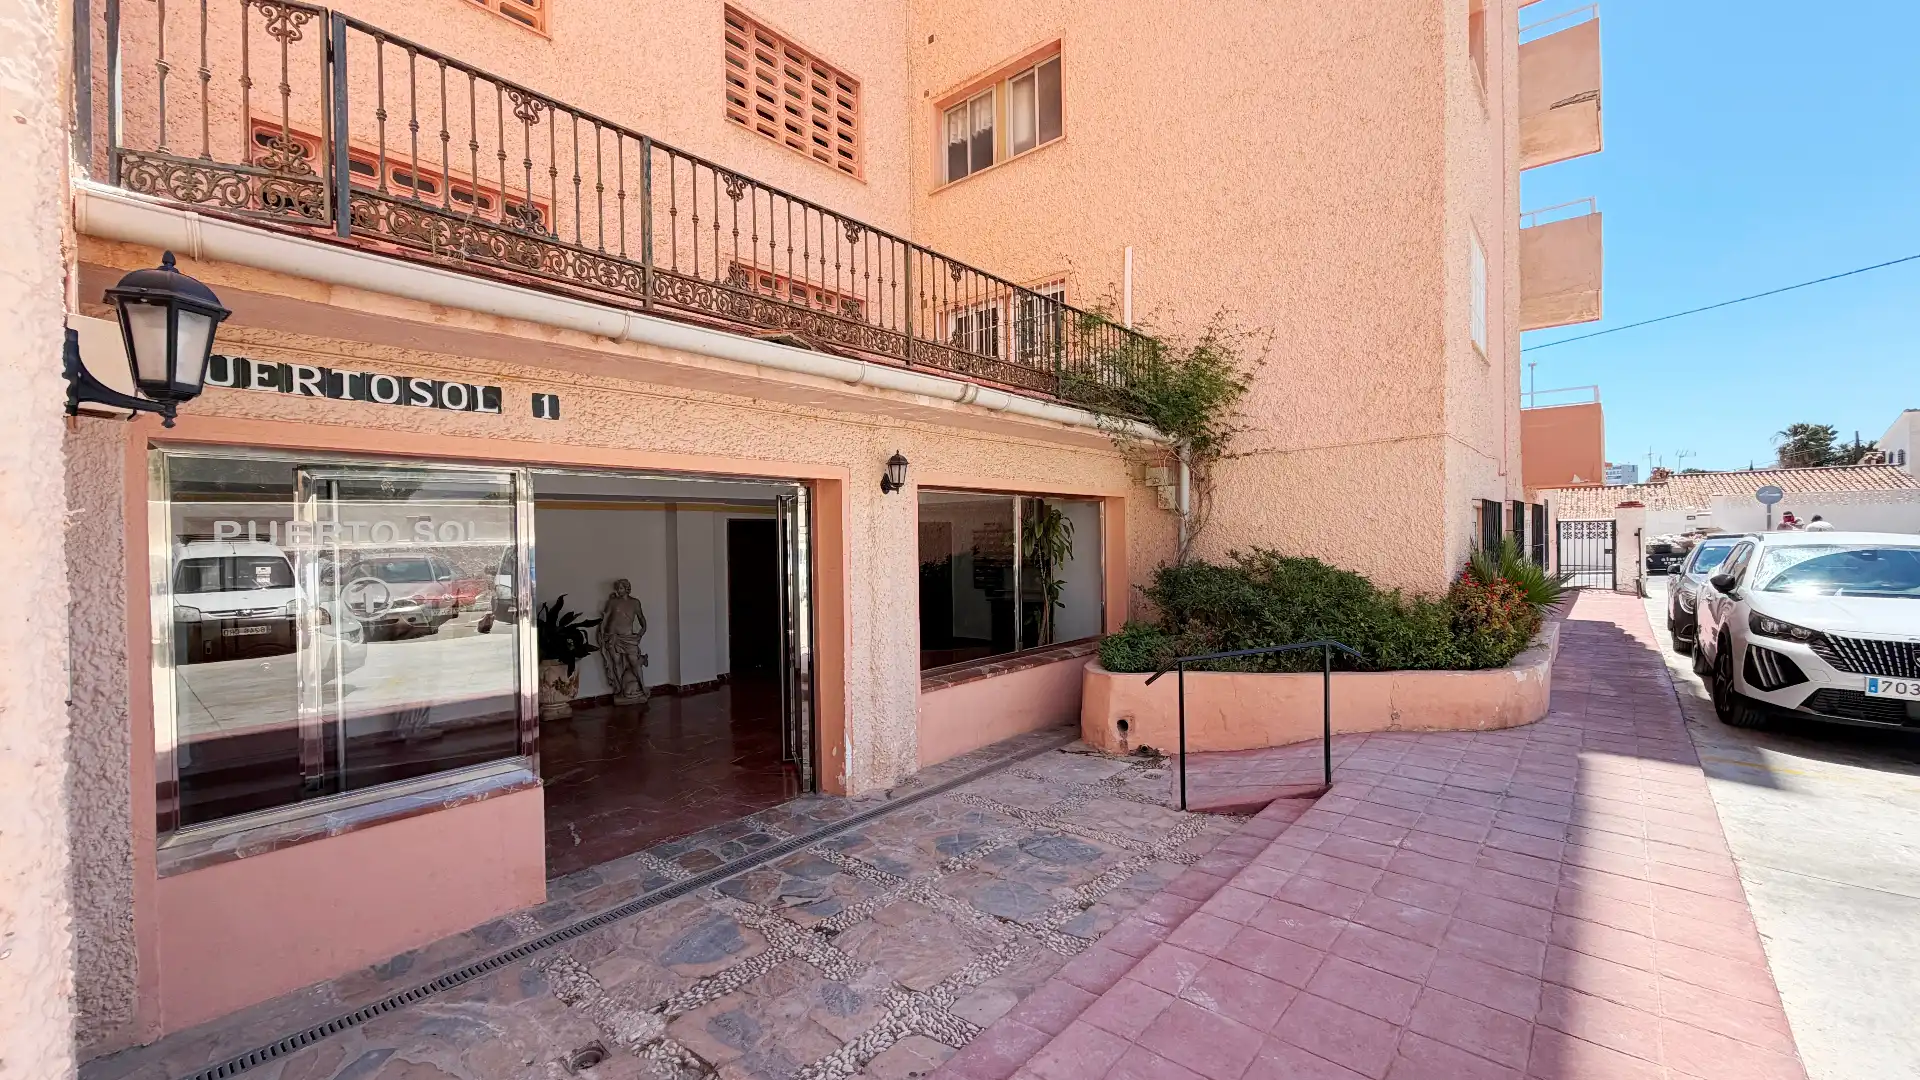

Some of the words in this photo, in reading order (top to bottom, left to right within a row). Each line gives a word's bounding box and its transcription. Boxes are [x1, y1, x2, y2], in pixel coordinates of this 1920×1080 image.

[203, 355, 500, 414] UERTOSOL
[540, 393, 555, 419] 1
[213, 520, 401, 549] PUERTO
